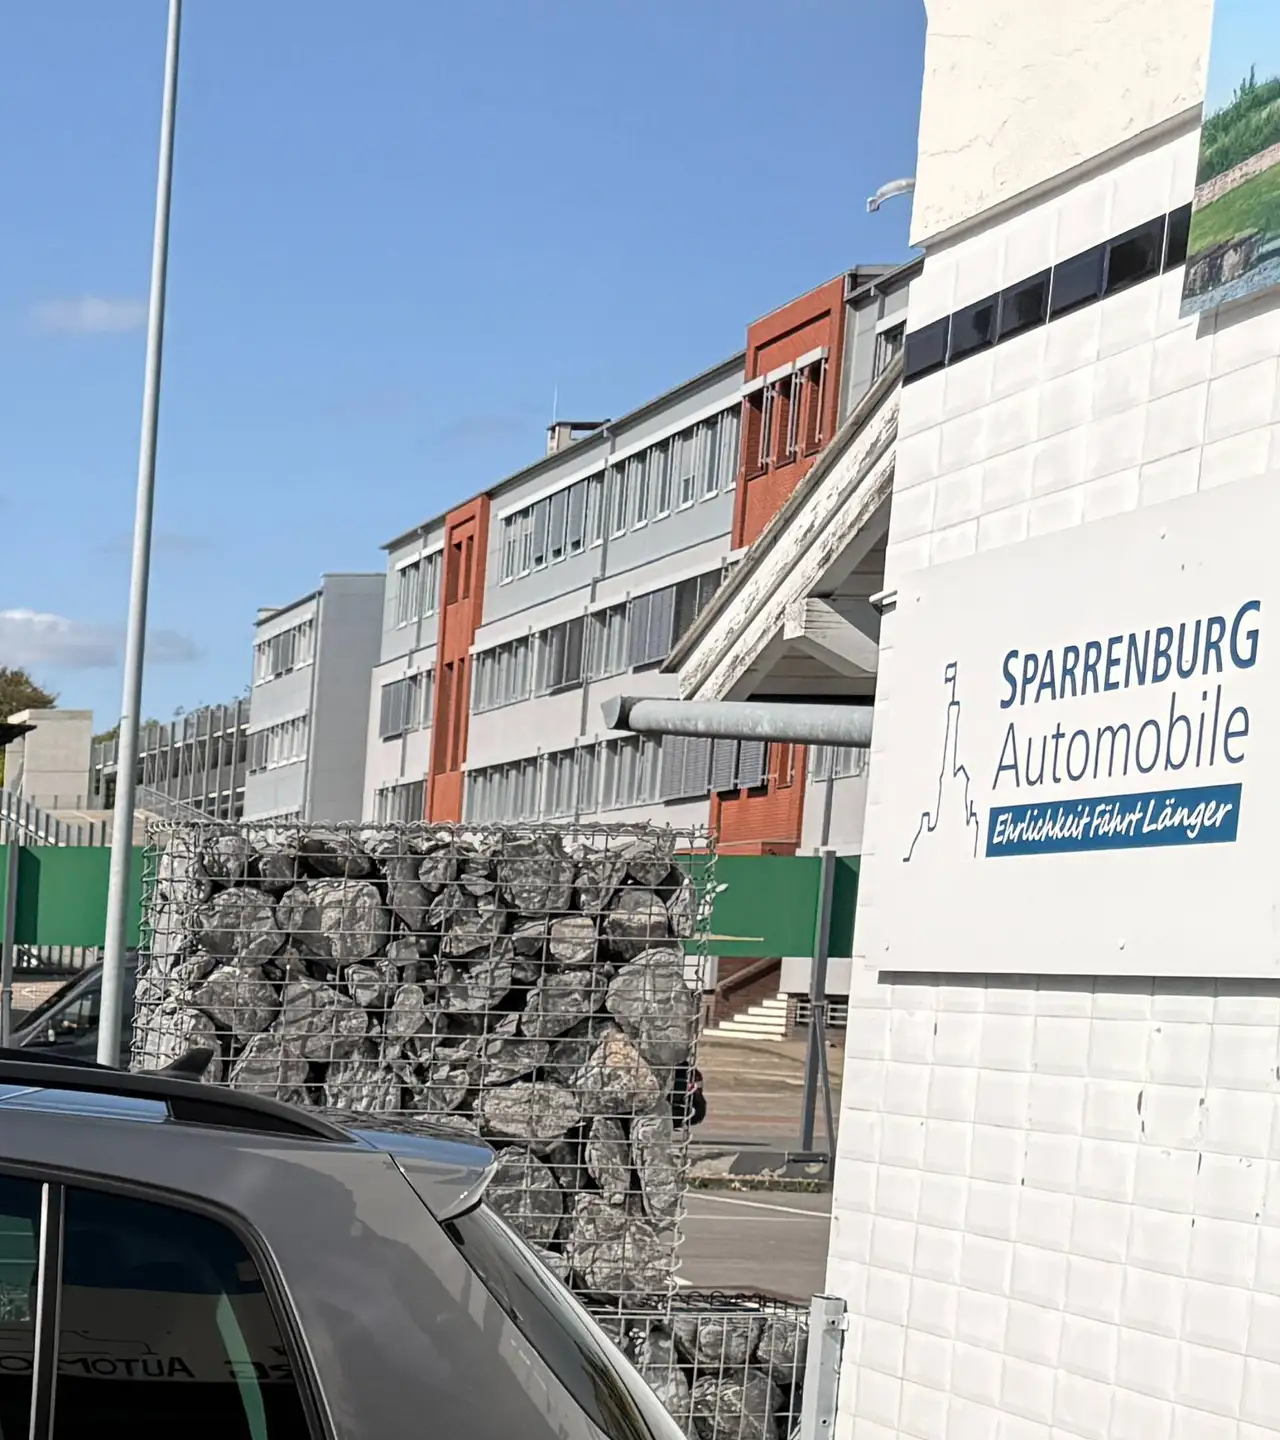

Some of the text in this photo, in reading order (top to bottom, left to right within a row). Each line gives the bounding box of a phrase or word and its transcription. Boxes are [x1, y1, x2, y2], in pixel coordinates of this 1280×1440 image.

[1000, 599, 1261, 709] SPARRENBURG
[992, 685, 1250, 790] Automobile
[992, 797, 1233, 845] Ehrlichkeit Fährt Länger
